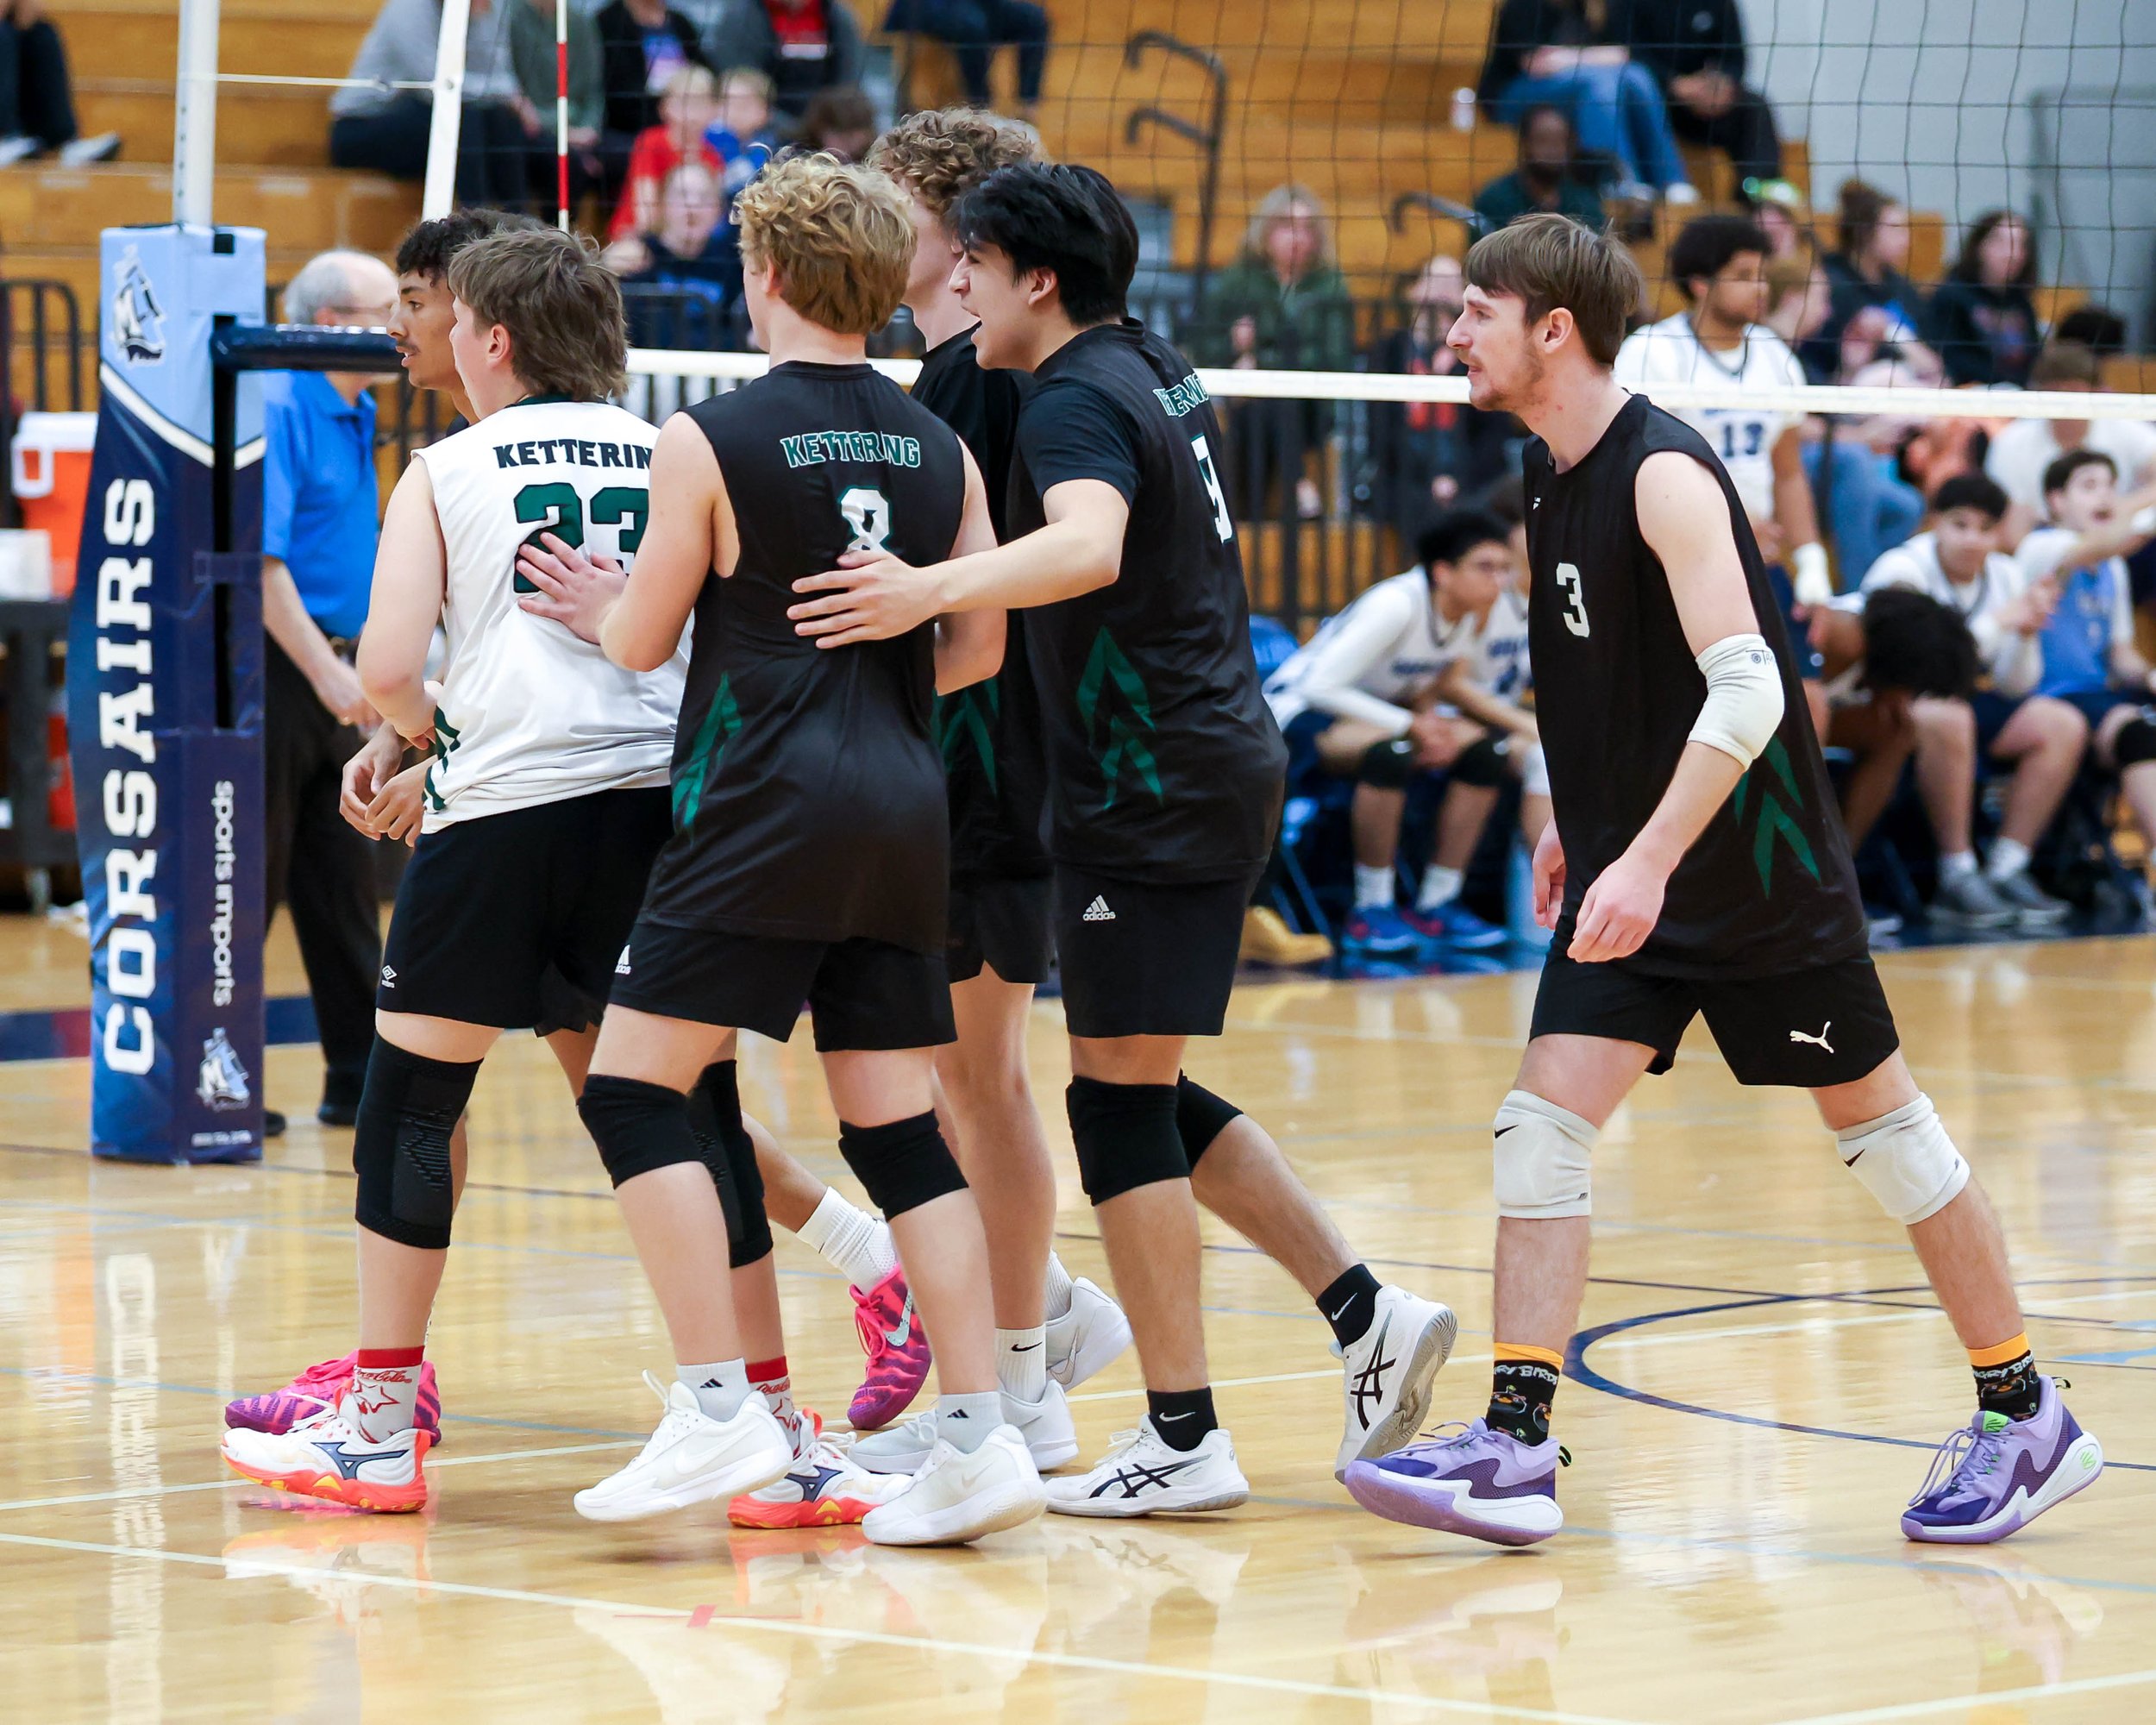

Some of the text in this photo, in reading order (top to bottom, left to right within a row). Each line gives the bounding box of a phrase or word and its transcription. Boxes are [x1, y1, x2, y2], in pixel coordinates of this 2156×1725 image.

[492, 439, 653, 469] KETTERIN
[780, 430, 921, 468] KETTERNG
[1556, 562, 1589, 638] 3
[97, 478, 157, 1076] CORSAIRS
[210, 781, 236, 881] sports
[1082, 911, 1116, 921] adidas
